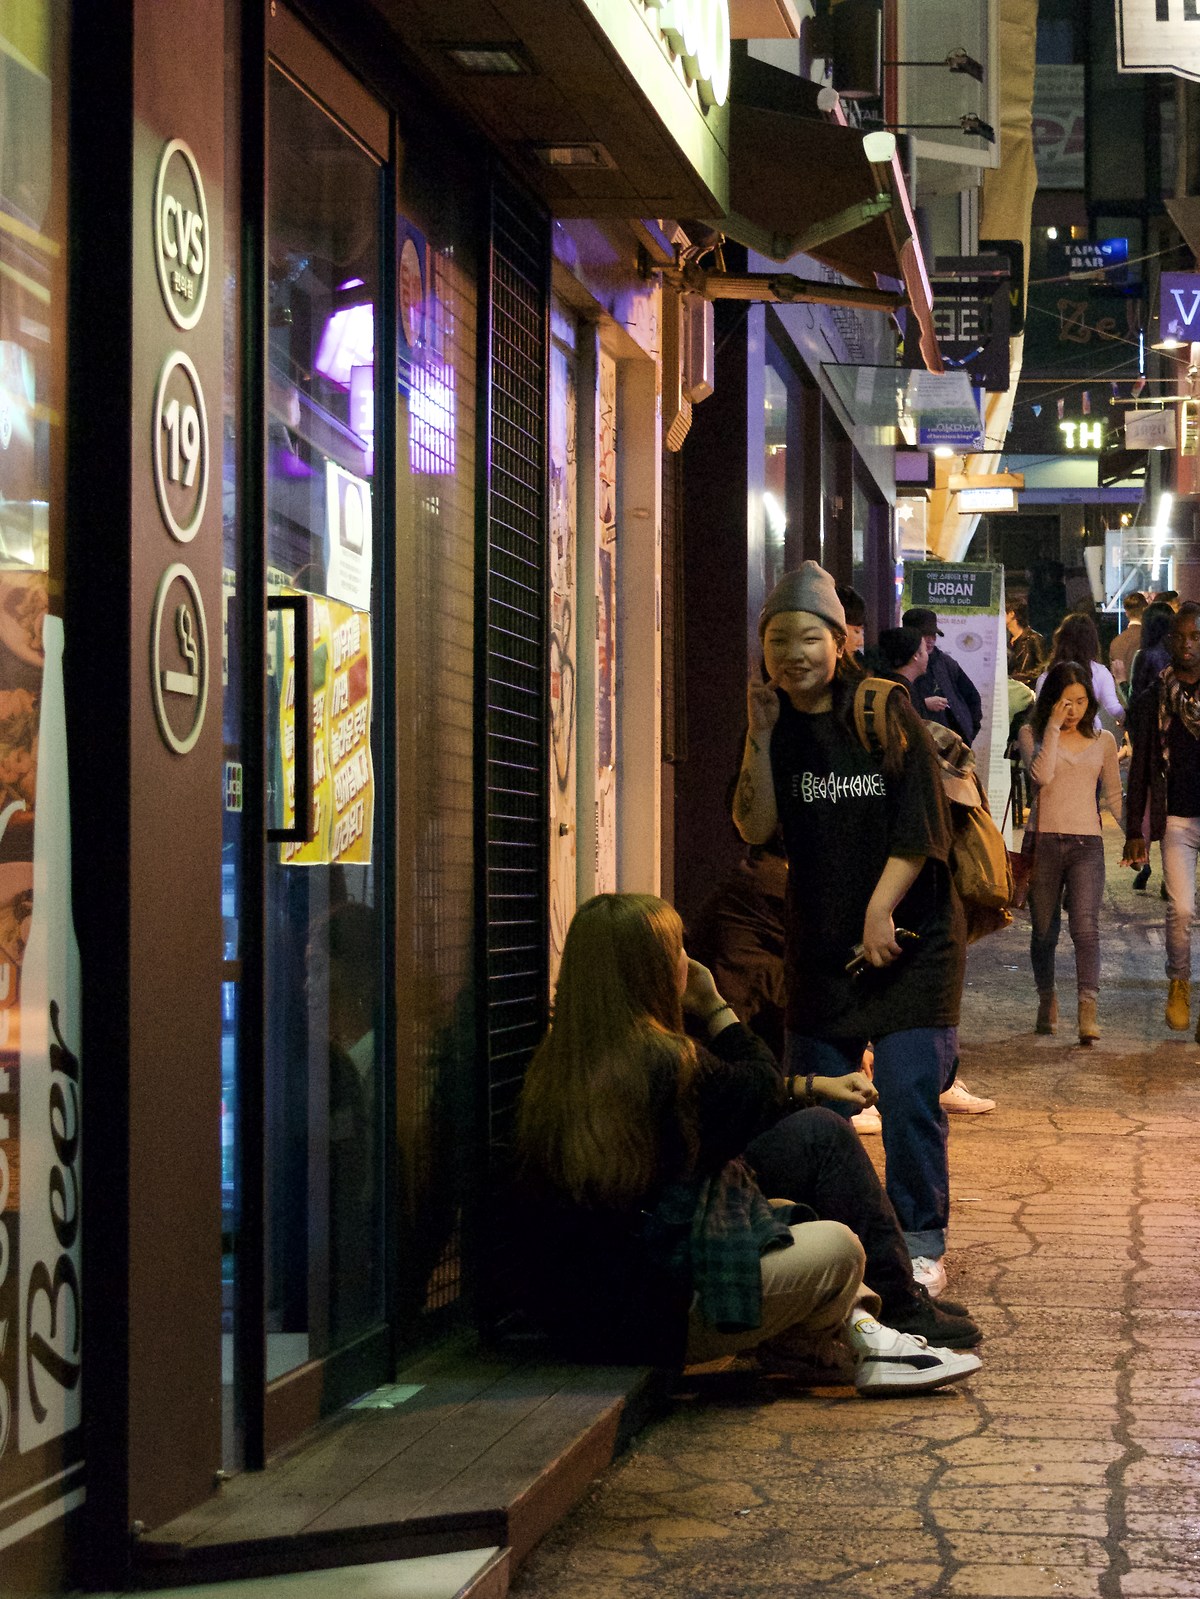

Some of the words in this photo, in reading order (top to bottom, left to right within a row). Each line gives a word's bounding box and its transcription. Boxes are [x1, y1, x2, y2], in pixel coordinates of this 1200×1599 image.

[163, 194, 204, 275] CVS
[1071, 257, 1104, 268] BAR
[172, 270, 194, 300] 편의점
[165, 399, 200, 487] 19
[1059, 421, 1102, 449] TH
[928, 582, 973, 596] URBAN
[928, 596, 947, 604] Steak
[957, 597, 971, 605] pub
[27, 1000, 80, 1424] Beer
